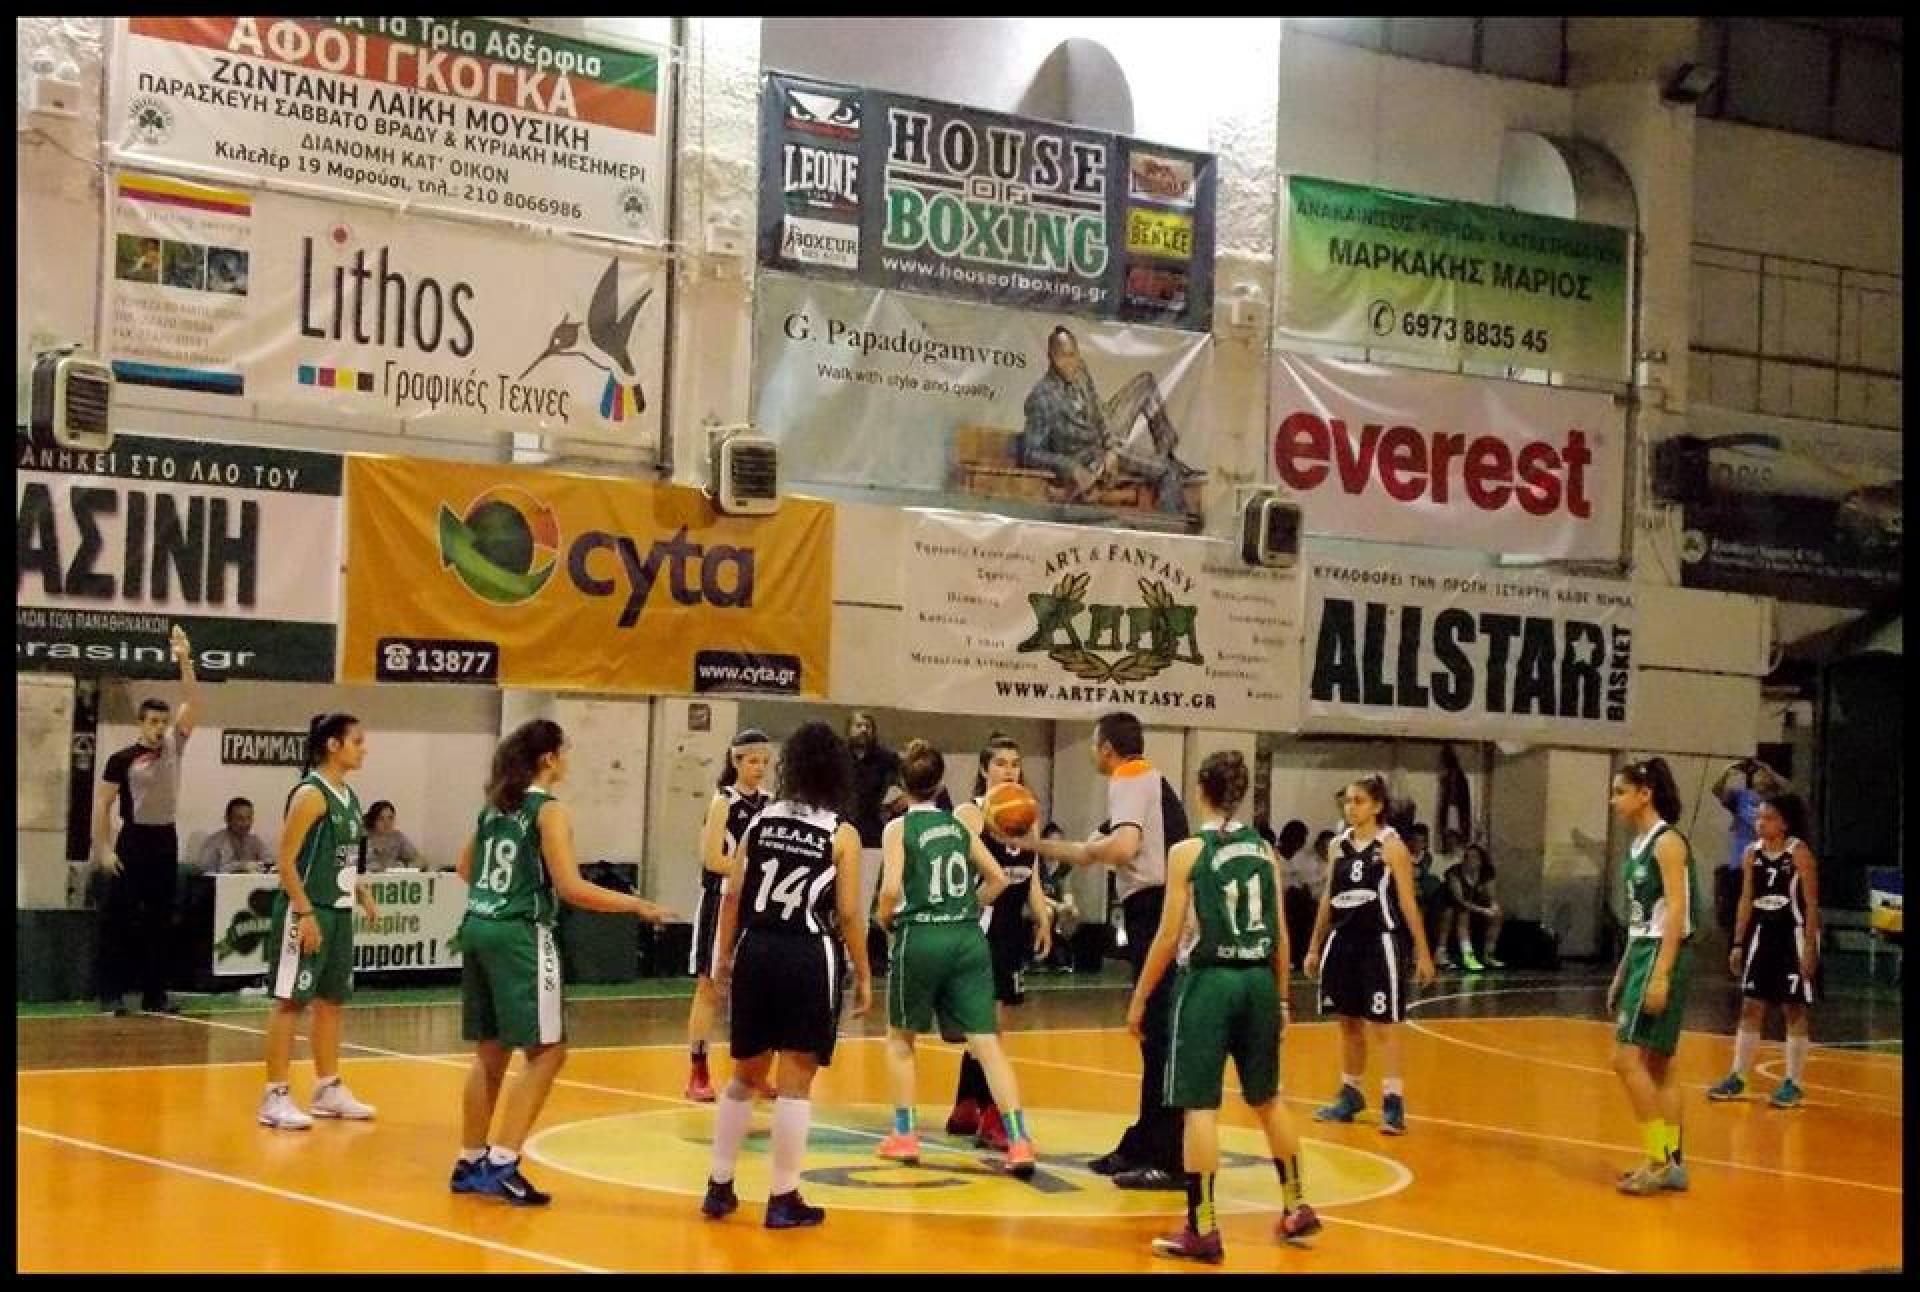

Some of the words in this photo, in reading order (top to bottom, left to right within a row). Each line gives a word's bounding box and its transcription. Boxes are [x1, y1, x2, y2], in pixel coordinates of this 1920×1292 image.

[228, 17, 367, 77] ΑΦΟΙ
[388, 43, 577, 118] ΓΚΟΓΚΑ
[420, 17, 477, 50] Τρία
[485, 31, 601, 77] Αδέρφια
[139, 73, 268, 112] ΠΑΡΑΣΚΕΥΗ
[275, 98, 368, 131] ΣΑΒΒΑΤΟ
[375, 118, 437, 144] ΒΡΑΔΥ
[444, 131, 456, 147] &
[465, 135, 546, 164] ΚΥΡΙΑΚΗ
[552, 152, 645, 183] ΜΕΣΗΜΕΡΙ
[212, 58, 359, 108] ΖΩΝΤΑΝΗ
[466, 107, 589, 152] ΜΟΥΣΙΚΗ
[301, 134, 395, 164] ΔΙΑΝΟΜΗ
[450, 160, 509, 184] ΟΙΚΟΝ
[784, 145, 859, 204] LEONE
[887, 106, 1107, 198] HOUSE
[215, 141, 290, 172] Κιλελέρ
[298, 156, 321, 175] 19
[463, 185, 499, 205] 210
[503, 191, 582, 219] 8066986
[971, 176, 1030, 206] OF
[882, 184, 1109, 278] BOXING
[301, 227, 476, 357] Lithos
[881, 256, 1107, 303] www.houseofboxing.gr
[1329, 237, 1485, 286] ΜΑΡΚΑΚΗΣ
[1492, 262, 1592, 301] ΜΑΡΙΟΣ
[784, 312, 817, 343] G.
[1403, 311, 1457, 341] 6973
[1463, 320, 1515, 351] 8835
[1521, 330, 1548, 353] 45
[384, 361, 488, 413] Γραφικές
[817, 363, 853, 381] Walk
[887, 374, 918, 391] style
[922, 379, 949, 394] and
[20, 446, 116, 473] ΑΝΗΚΕΙ
[131, 455, 176, 478] ΣΤΟ
[189, 461, 241, 484] ΛΑΟ
[254, 465, 299, 489] ΤΟΥ
[1274, 410, 1593, 519] everest
[17, 482, 259, 609] ΑΣΙΝΗ
[1045, 547, 1081, 577] ART
[1109, 543, 1197, 593] FANTASY
[567, 522, 755, 629] cyta
[416, 647, 492, 675] 13877
[698, 664, 797, 687] www.cyta.gr
[1310, 597, 1606, 721] ALLSTAR
[1606, 623, 1634, 722] BASKET
[995, 680, 1218, 711] WWW.ARTFANTASY.GR
[475, 836, 518, 893] 18
[754, 857, 811, 921] 14
[927, 850, 969, 904] 10
[1349, 858, 1363, 883] 8
[1766, 866, 1778, 887] 7
[1222, 872, 1266, 935] 11
[430, 937, 437, 966] !
[1371, 991, 1387, 1015] 8
[1787, 973, 1799, 995] 7
